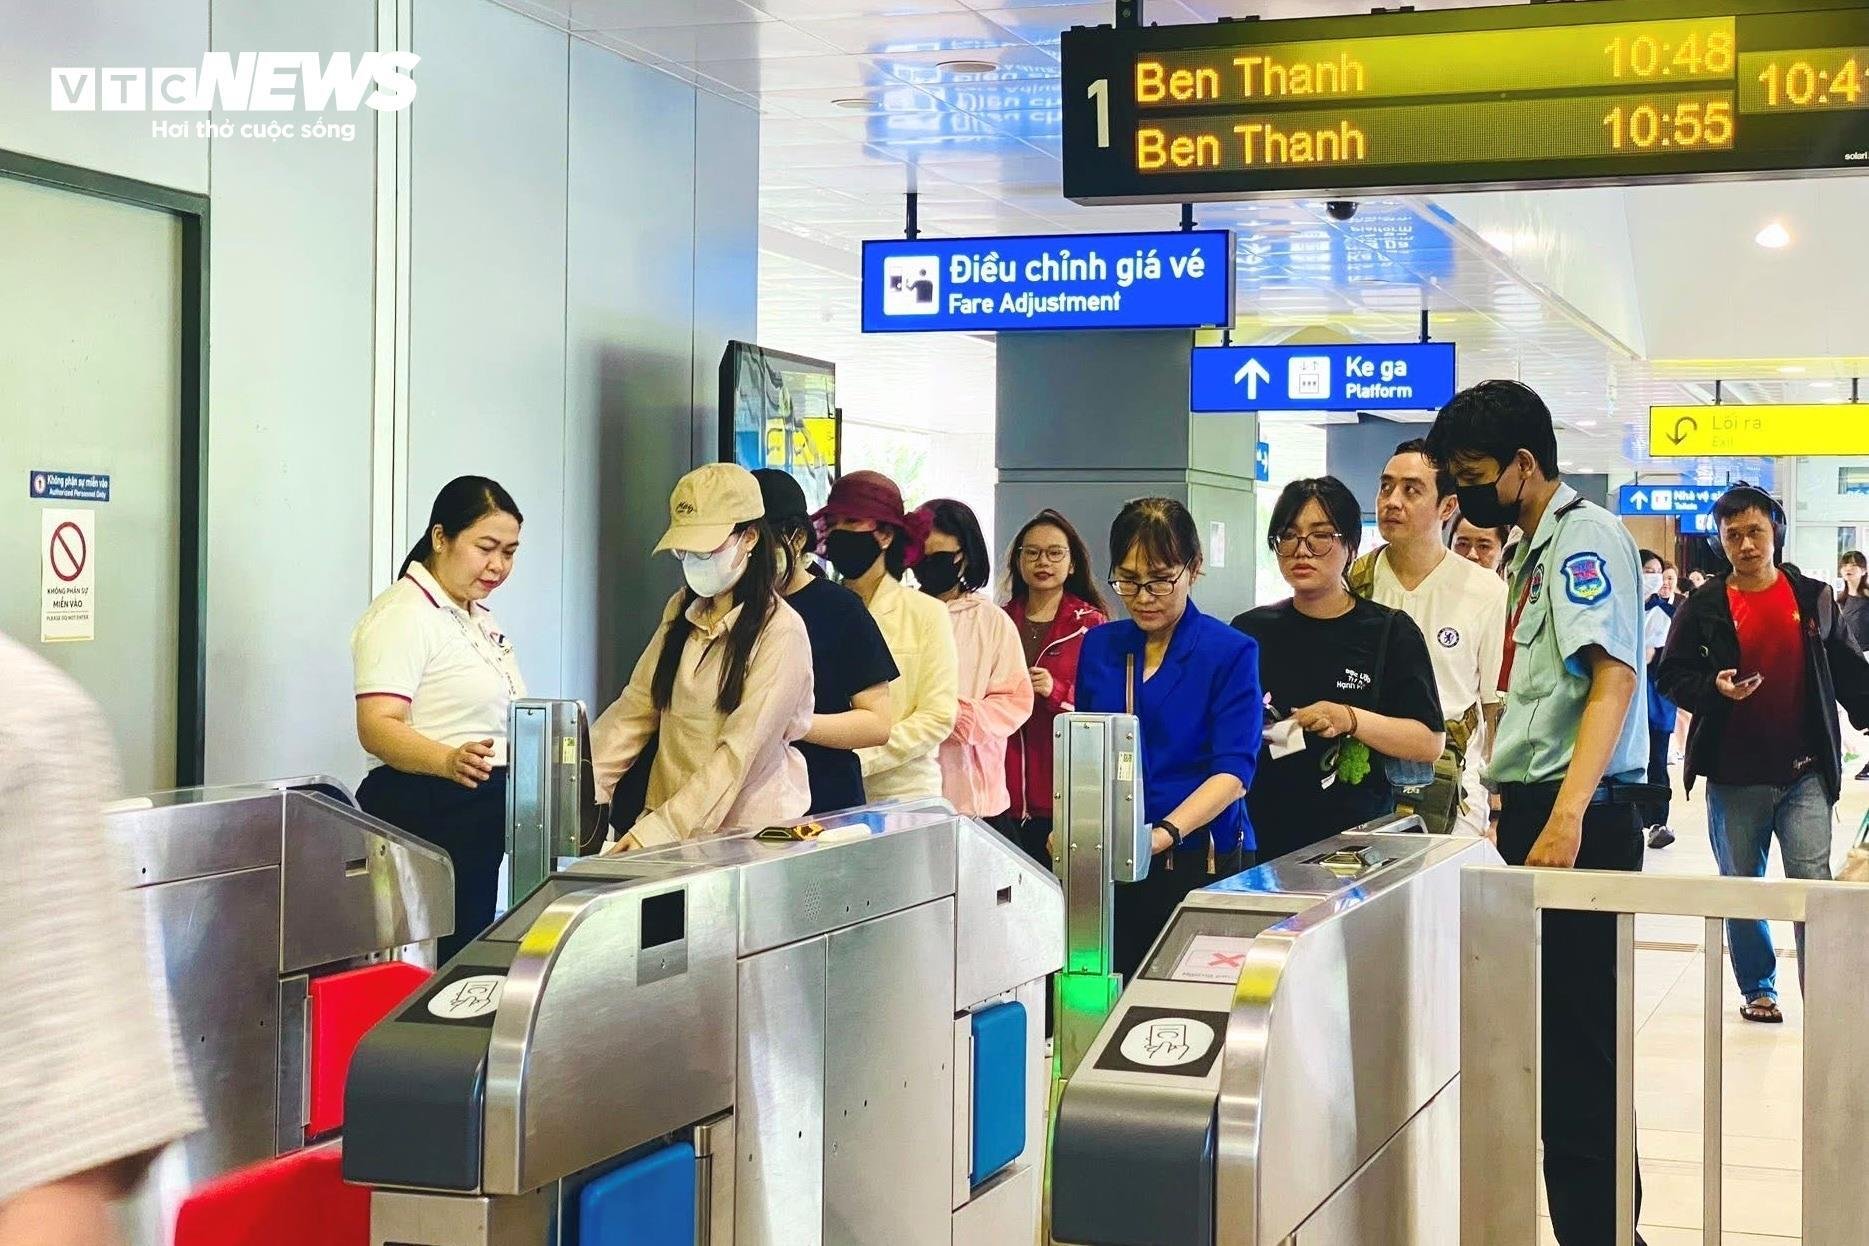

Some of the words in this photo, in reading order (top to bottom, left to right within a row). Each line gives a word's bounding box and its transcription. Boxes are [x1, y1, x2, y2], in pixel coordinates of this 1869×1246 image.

[1136, 62, 1220, 102] Ben
[1233, 53, 1365, 96] Thanh
[1604, 31, 1733, 78] 10:48
[1758, 57, 1869, 105] 10:4
[1086, 79, 1111, 148] 1
[1137, 128, 1221, 169] Ben
[1233, 120, 1365, 164] Thanh
[1603, 100, 1733, 148] 10:55
[949, 251, 1017, 284] Điều
[1025, 249, 1107, 282] chỉnh
[1116, 248, 1162, 288] giá
[1169, 248, 1206, 279] vé
[948, 293, 994, 315] Fare
[999, 290, 1122, 318] Adjustment
[1346, 355, 1375, 378] Ke
[1380, 360, 1408, 382] ga
[1345, 382, 1413, 399] Platform
[1744, 418, 1761, 430] ra
